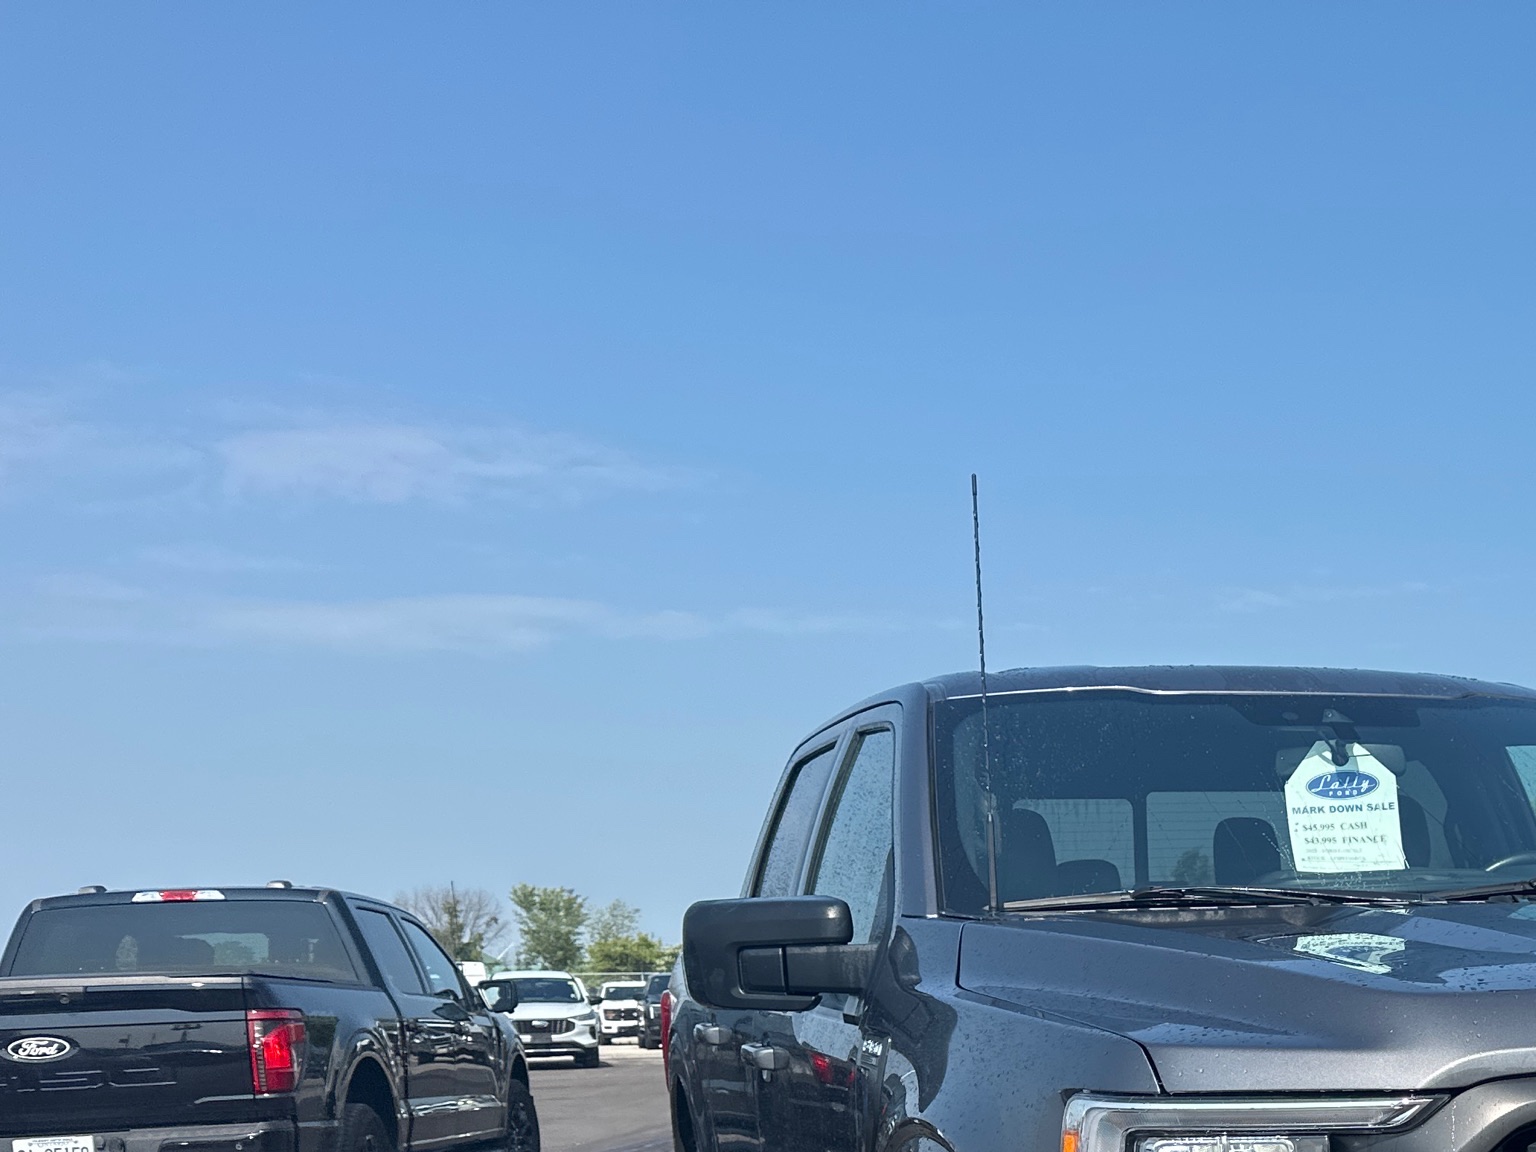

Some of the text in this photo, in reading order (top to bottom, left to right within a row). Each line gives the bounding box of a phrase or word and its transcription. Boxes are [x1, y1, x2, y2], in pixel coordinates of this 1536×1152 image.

[1311, 774, 1376, 793] Lally
[1328, 789, 1358, 797] FORD
[1291, 801, 1396, 815] MARK DOWN SALE
[1340, 821, 1368, 831] CASH
[1342, 833, 1388, 845] FINANCE
[18, 1040, 61, 1057] Ford
